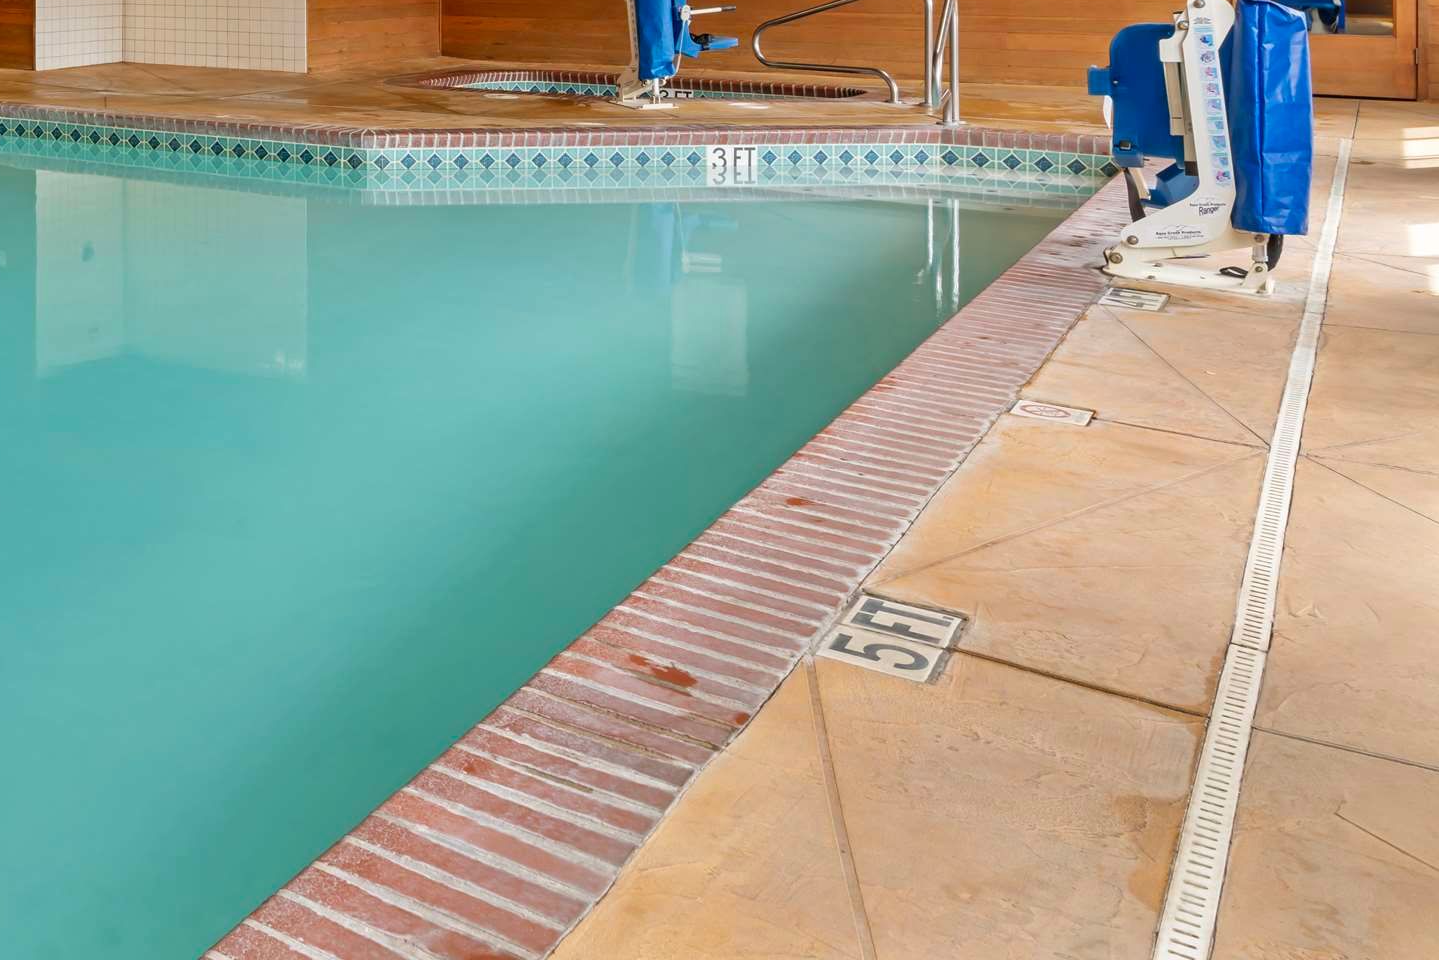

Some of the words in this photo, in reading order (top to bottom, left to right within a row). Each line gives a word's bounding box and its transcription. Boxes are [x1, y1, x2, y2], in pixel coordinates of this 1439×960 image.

[712, 147, 727, 168] 3
[734, 147, 755, 167] FT
[1199, 207, 1219, 216] Ranger
[830, 633, 930, 671] 5
